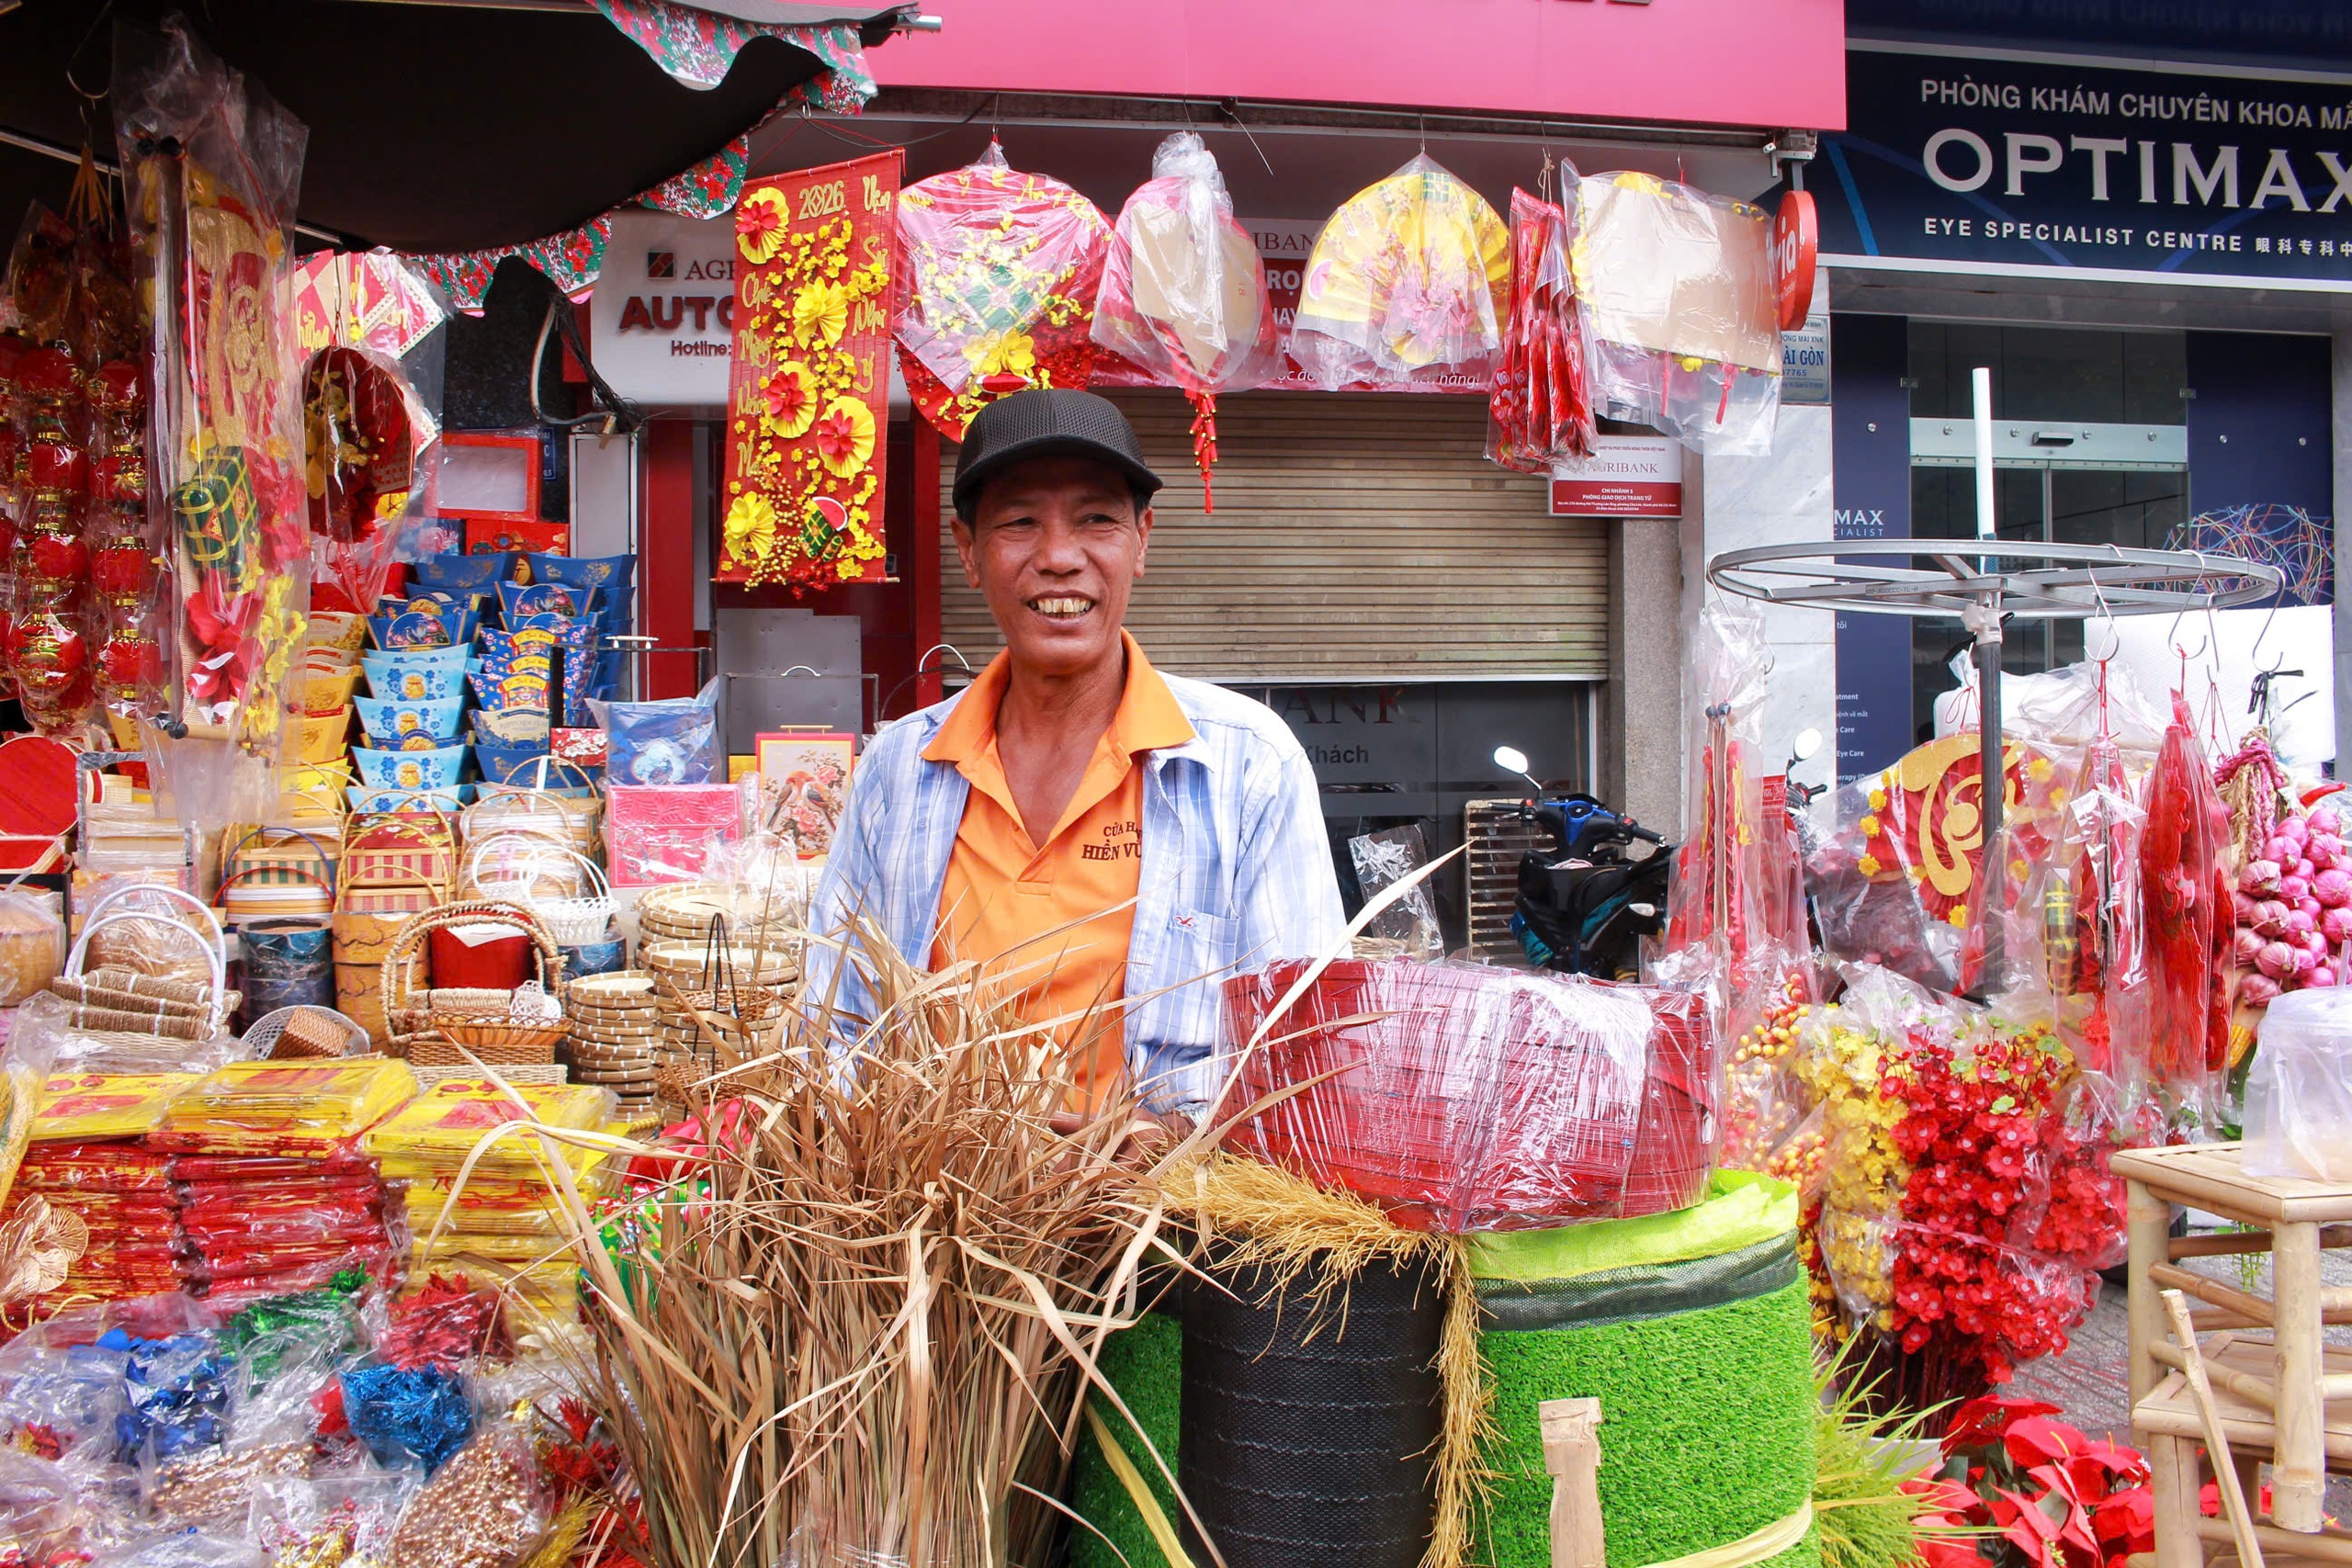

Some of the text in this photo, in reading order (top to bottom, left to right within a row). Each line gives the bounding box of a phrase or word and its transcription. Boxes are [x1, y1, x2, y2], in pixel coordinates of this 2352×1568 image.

[1921, 73, 2021, 109] PHÒNG
[2031, 84, 2109, 116] KHÁM
[2119, 92, 2229, 122] CHUYÊN
[2238, 101, 2312, 128] KHOA
[1923, 128, 2352, 213] OPTIMAX
[798, 180, 844, 220] 2026
[1252, 231, 1313, 252] IBAN
[1924, 218, 2242, 252] EYE SPECIALIST CENTRE
[671, 340, 732, 357] Hotline:
[1782, 344, 1824, 366] ÀI GÒN
[1102, 821, 1124, 837] CỬA
[1081, 839, 1121, 861] HIỀN
